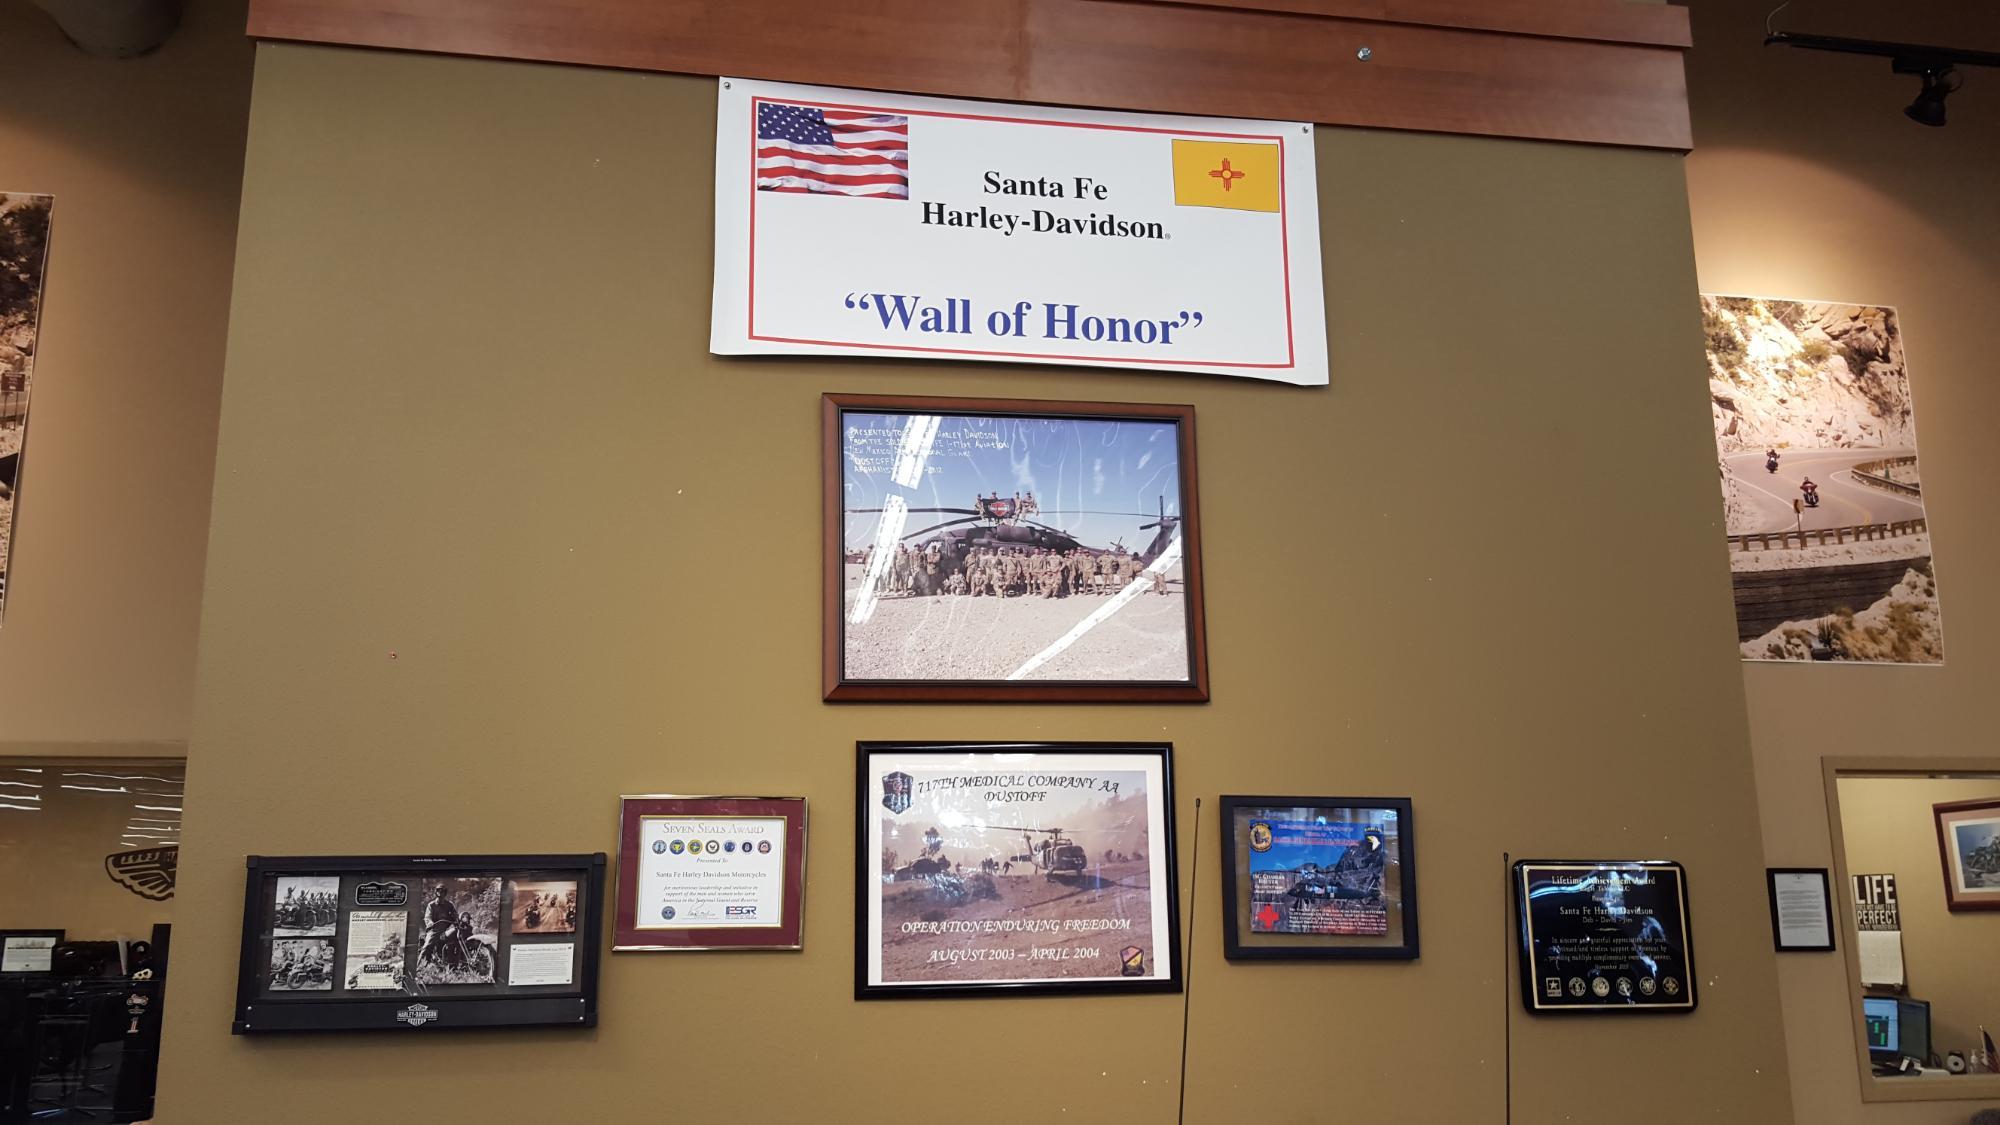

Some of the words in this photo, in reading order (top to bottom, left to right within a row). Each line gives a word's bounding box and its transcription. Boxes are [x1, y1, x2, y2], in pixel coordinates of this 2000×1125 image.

[983, 170, 1064, 199] Santa
[1074, 175, 1108, 201] Fe
[921, 201, 1165, 240] Harley-Davidson
[843, 292, 971, 335] “Wall
[987, 301, 1031, 338] of
[1043, 303, 1203, 346] Honor”
[918, 775, 958, 793] 717TH
[959, 775, 1024, 789] MEDICAL
[1028, 775, 1097, 791] COMPANY
[983, 790, 1047, 803] DUSTOFF
[682, 871, 702, 880] Harley
[731, 871, 767, 879] Motorcycles
[1552, 875, 1583, 885] Lifetime
[1853, 875, 1896, 904] LIFE
[1559, 906, 1580, 916] Santa
[1582, 906, 1591, 916] Fe
[1857, 910, 1897, 925] PERFECT
[901, 919, 985, 934] OPERATION
[983, 918, 1060, 934] ENDURING
[1063, 918, 1131, 931] FREEDOM
[927, 949, 988, 964] AUGUST
[989, 948, 1015, 961] 2003
[1027, 946, 1071, 961] APRIL
[1073, 947, 1100, 960] 2004
